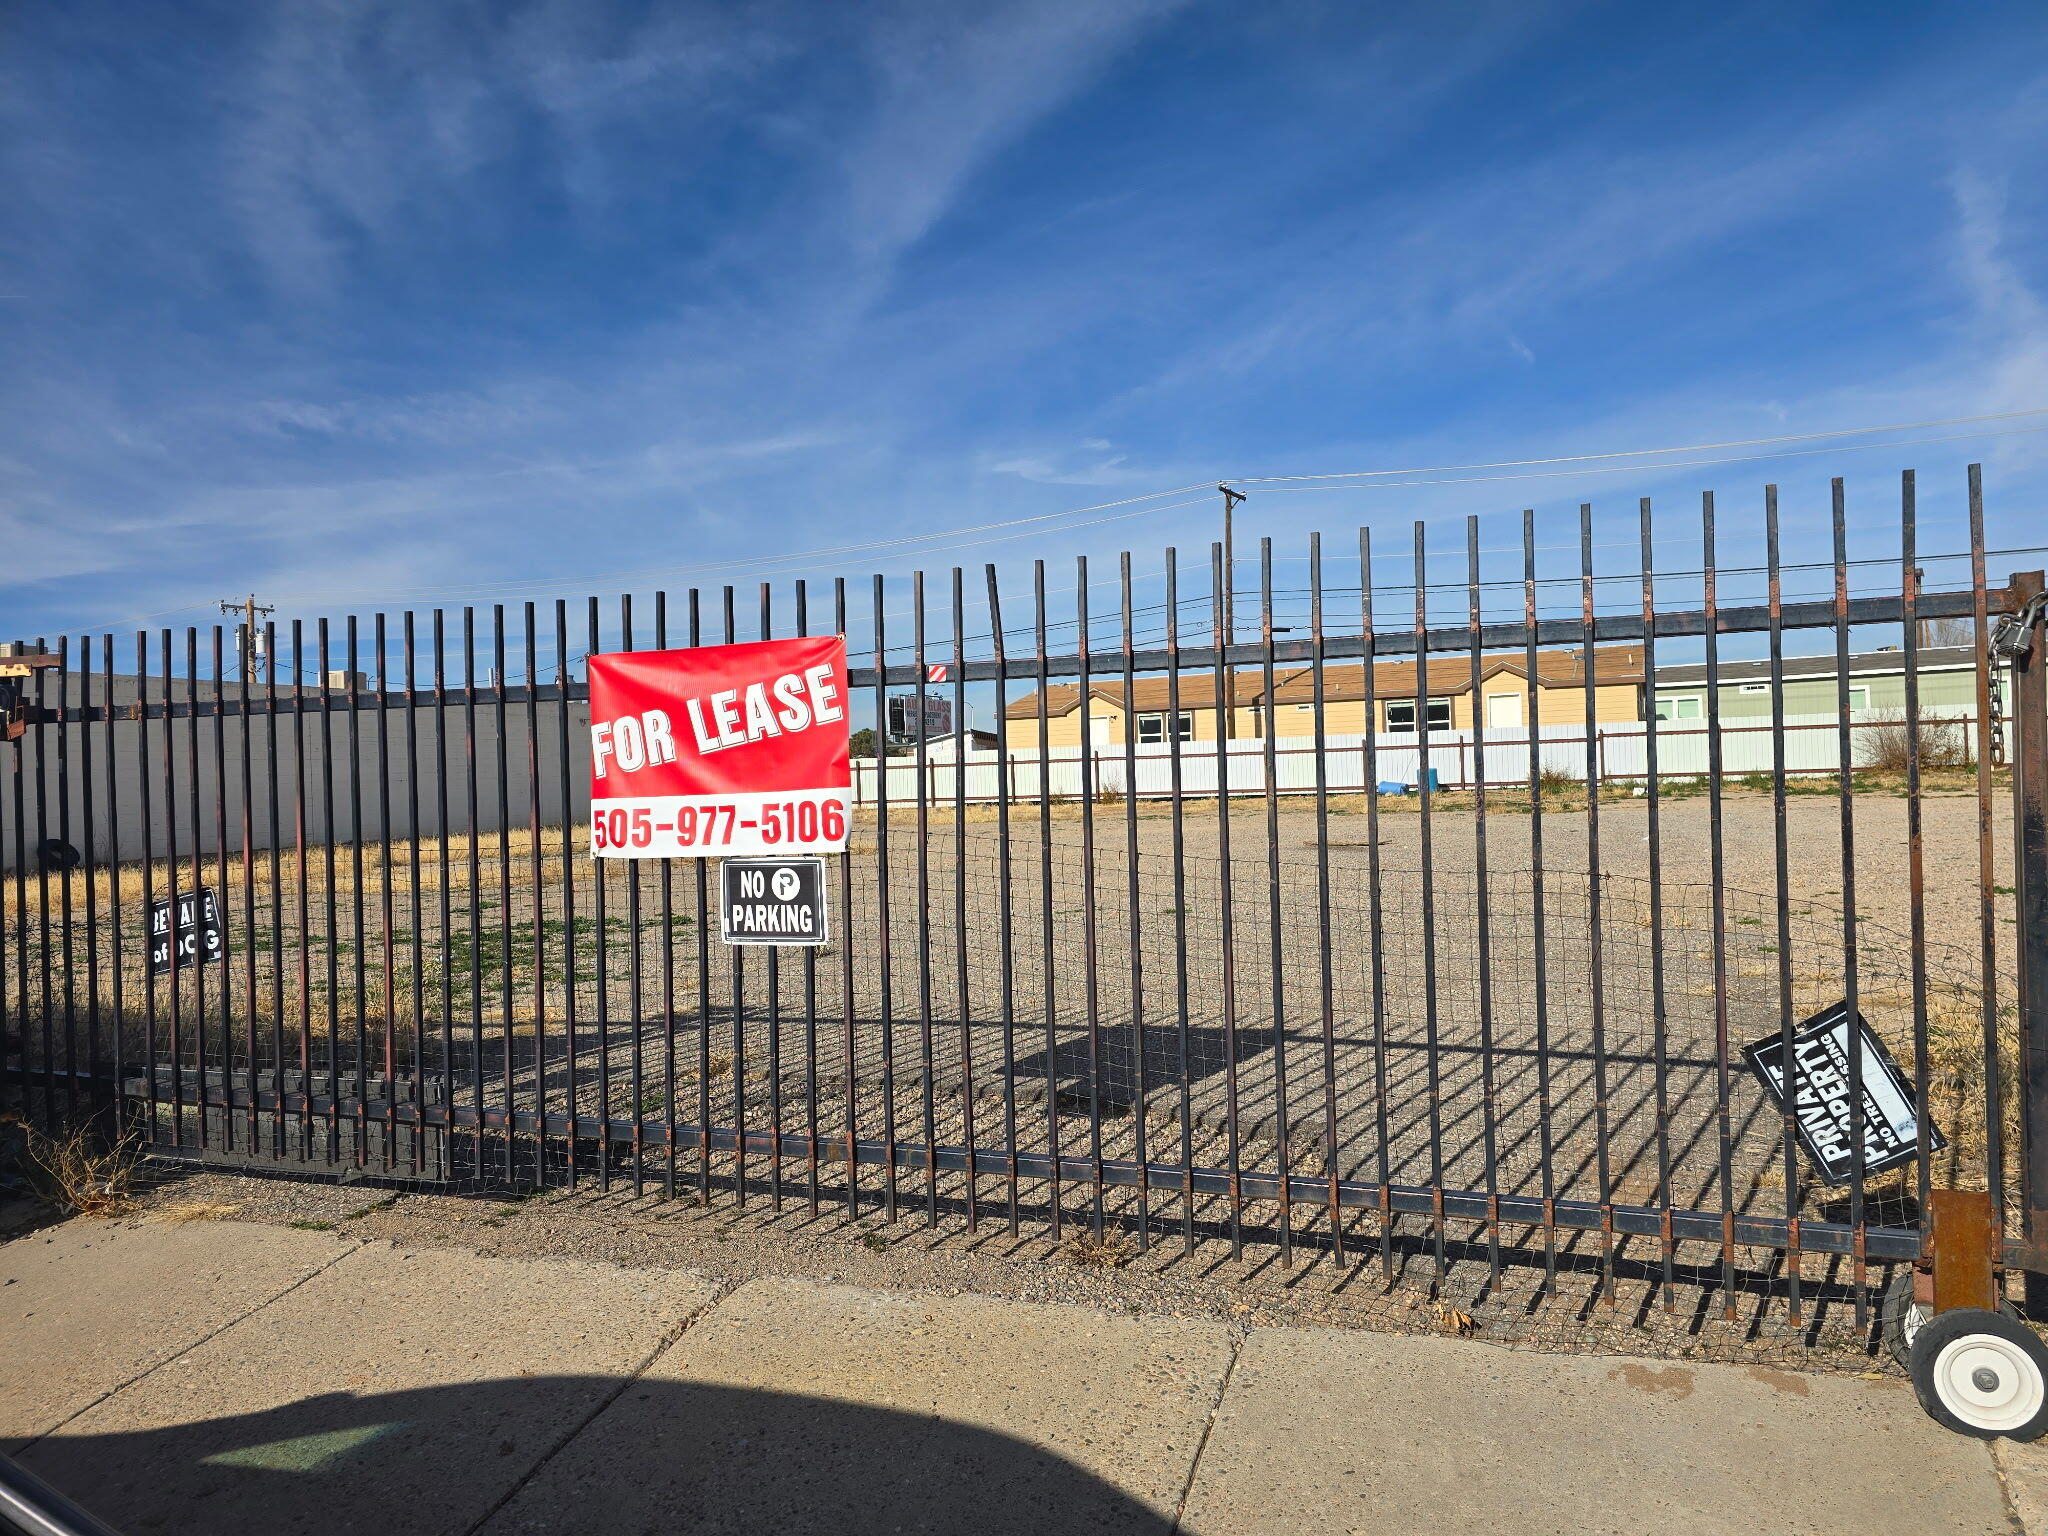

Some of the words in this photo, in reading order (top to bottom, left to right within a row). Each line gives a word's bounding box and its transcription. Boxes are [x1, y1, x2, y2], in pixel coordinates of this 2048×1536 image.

[591, 709, 677, 779] FOR
[687, 663, 843, 755] LEASE
[928, 700, 951, 712] GLASS
[594, 799, 845, 849] 505-977-5106
[740, 870, 765, 898] NO
[152, 896, 213, 933] EAE
[733, 904, 813, 933] PARKING
[154, 942, 168, 963] of
[175, 929, 219, 957] OG
[1820, 1033, 1883, 1126] TRESSSING
[1880, 1127, 1899, 1148] NO
